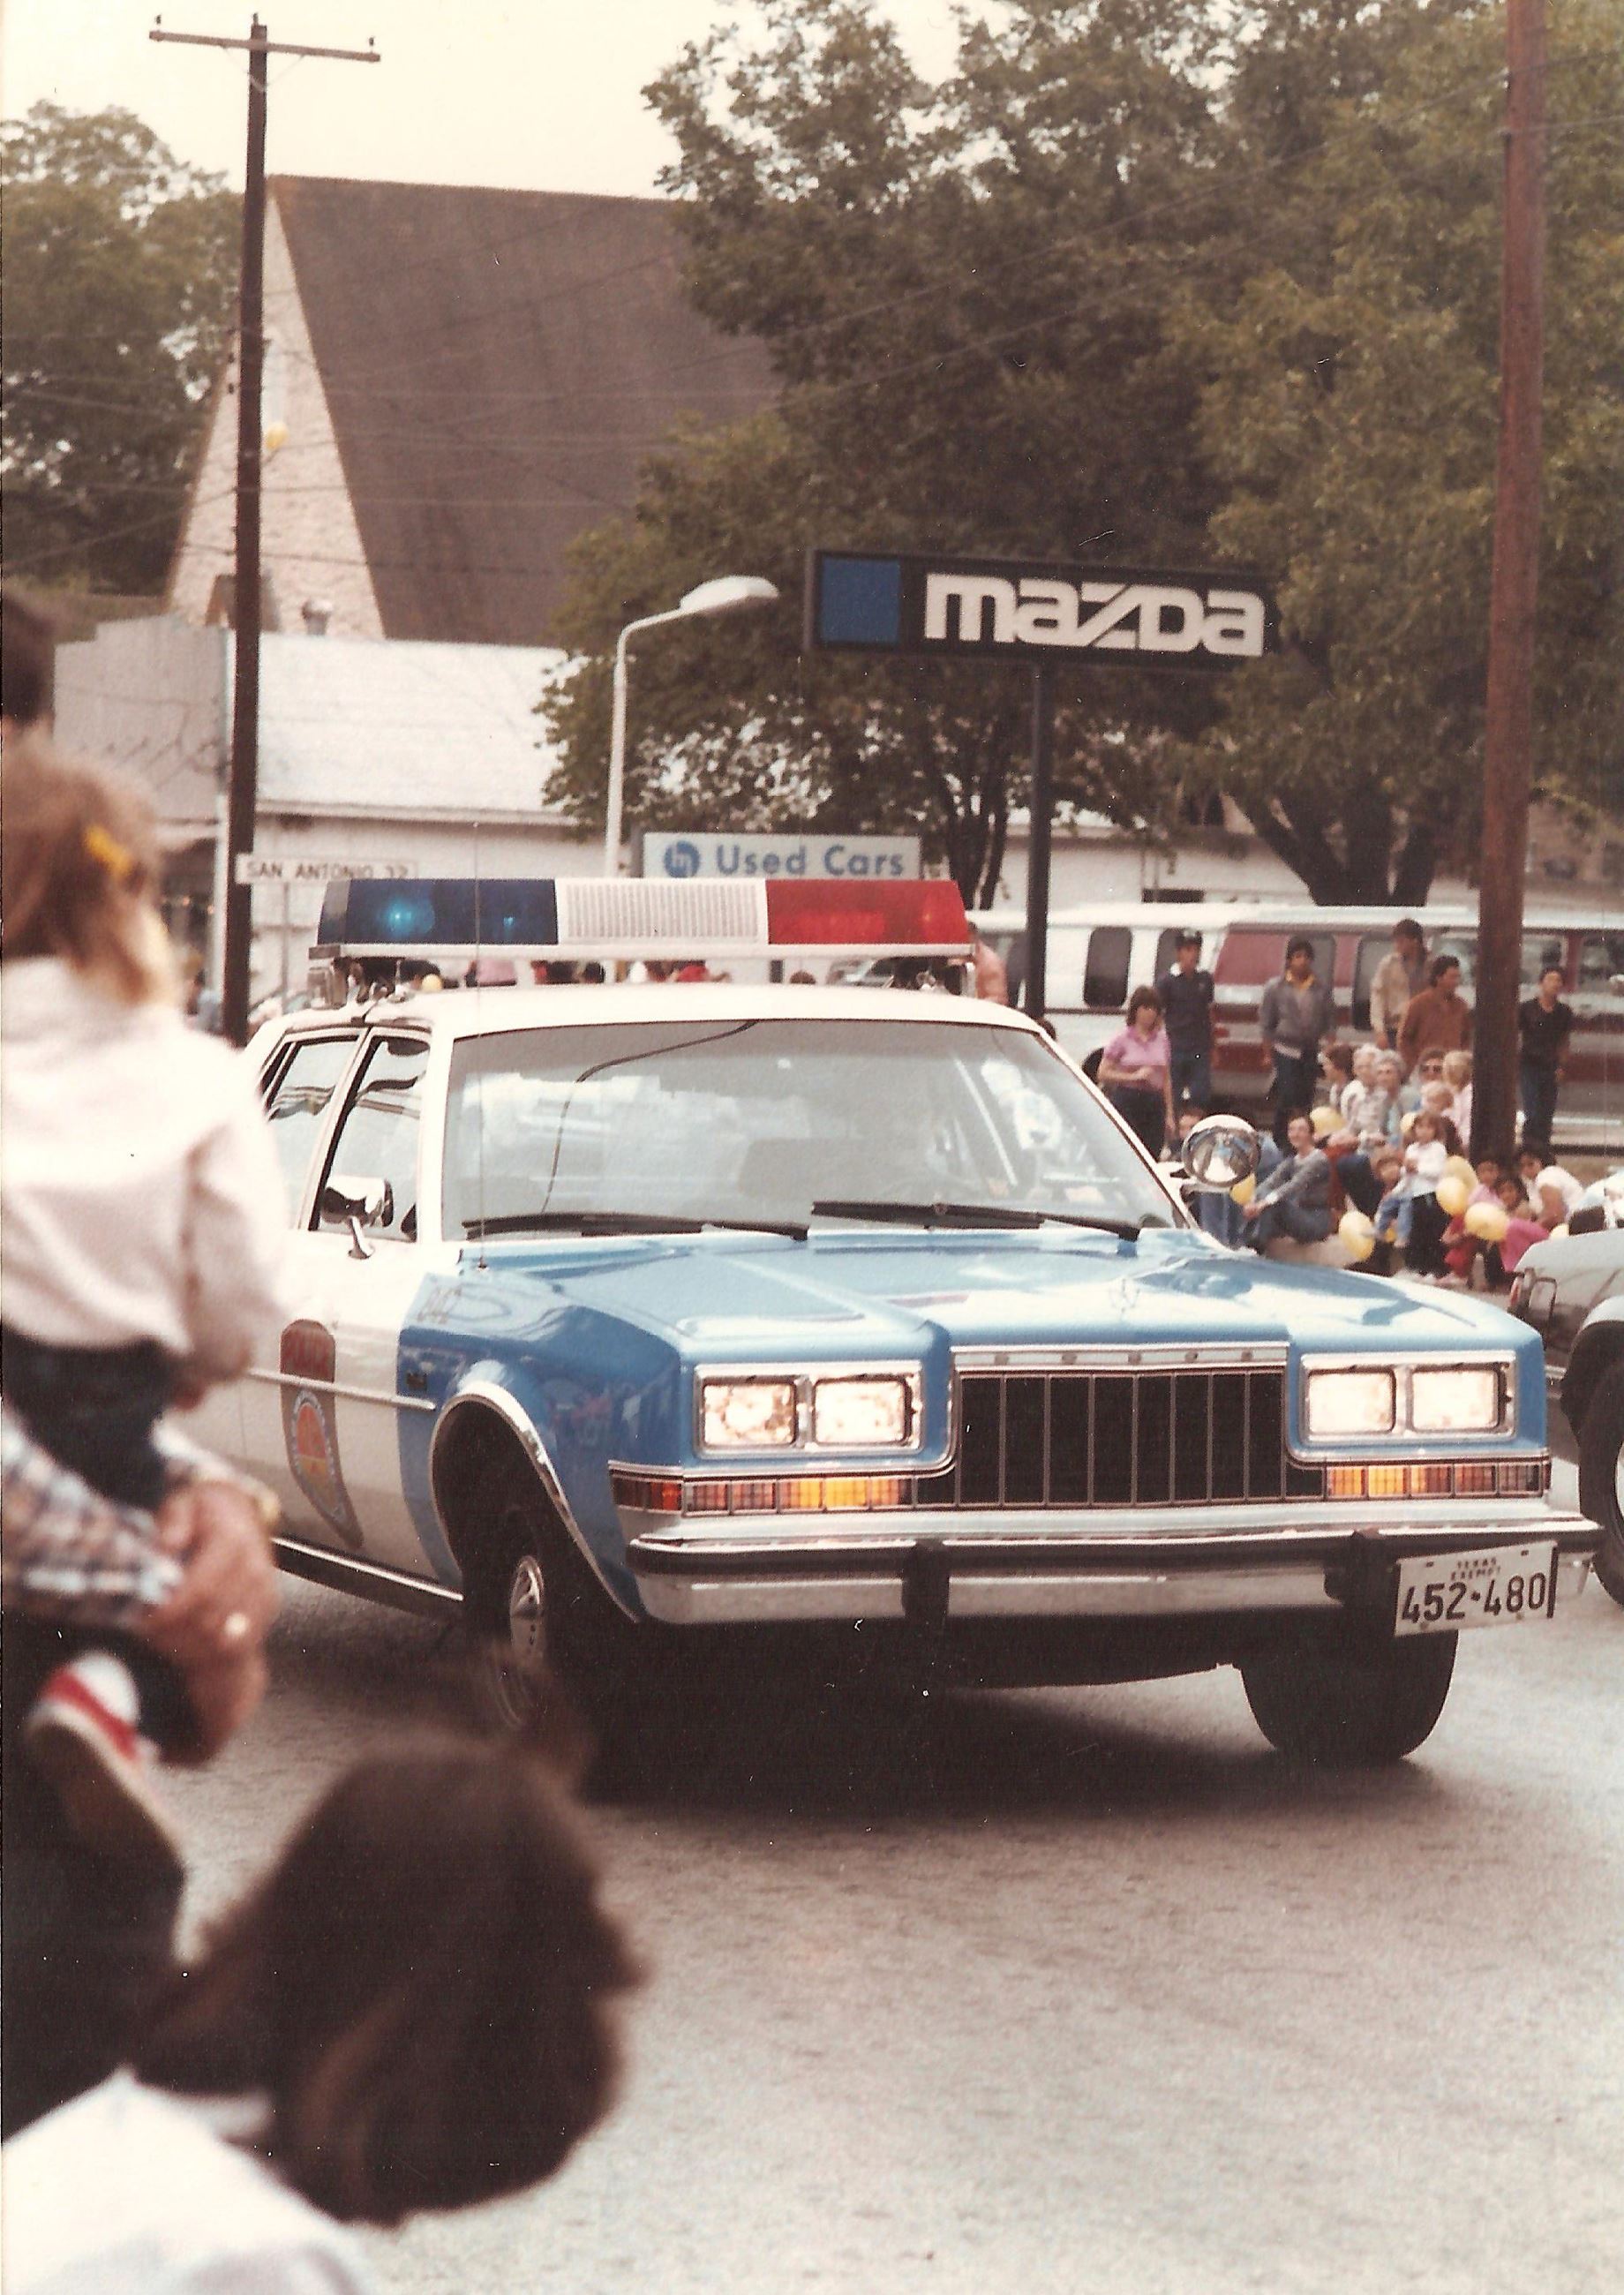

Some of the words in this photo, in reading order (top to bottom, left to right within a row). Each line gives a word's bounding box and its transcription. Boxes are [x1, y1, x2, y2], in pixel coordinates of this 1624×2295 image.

[247, 861, 282, 877] SAN
[296, 862, 374, 879] ANTONIO
[716, 844, 807, 876] Used
[823, 845, 905, 876] Cars
